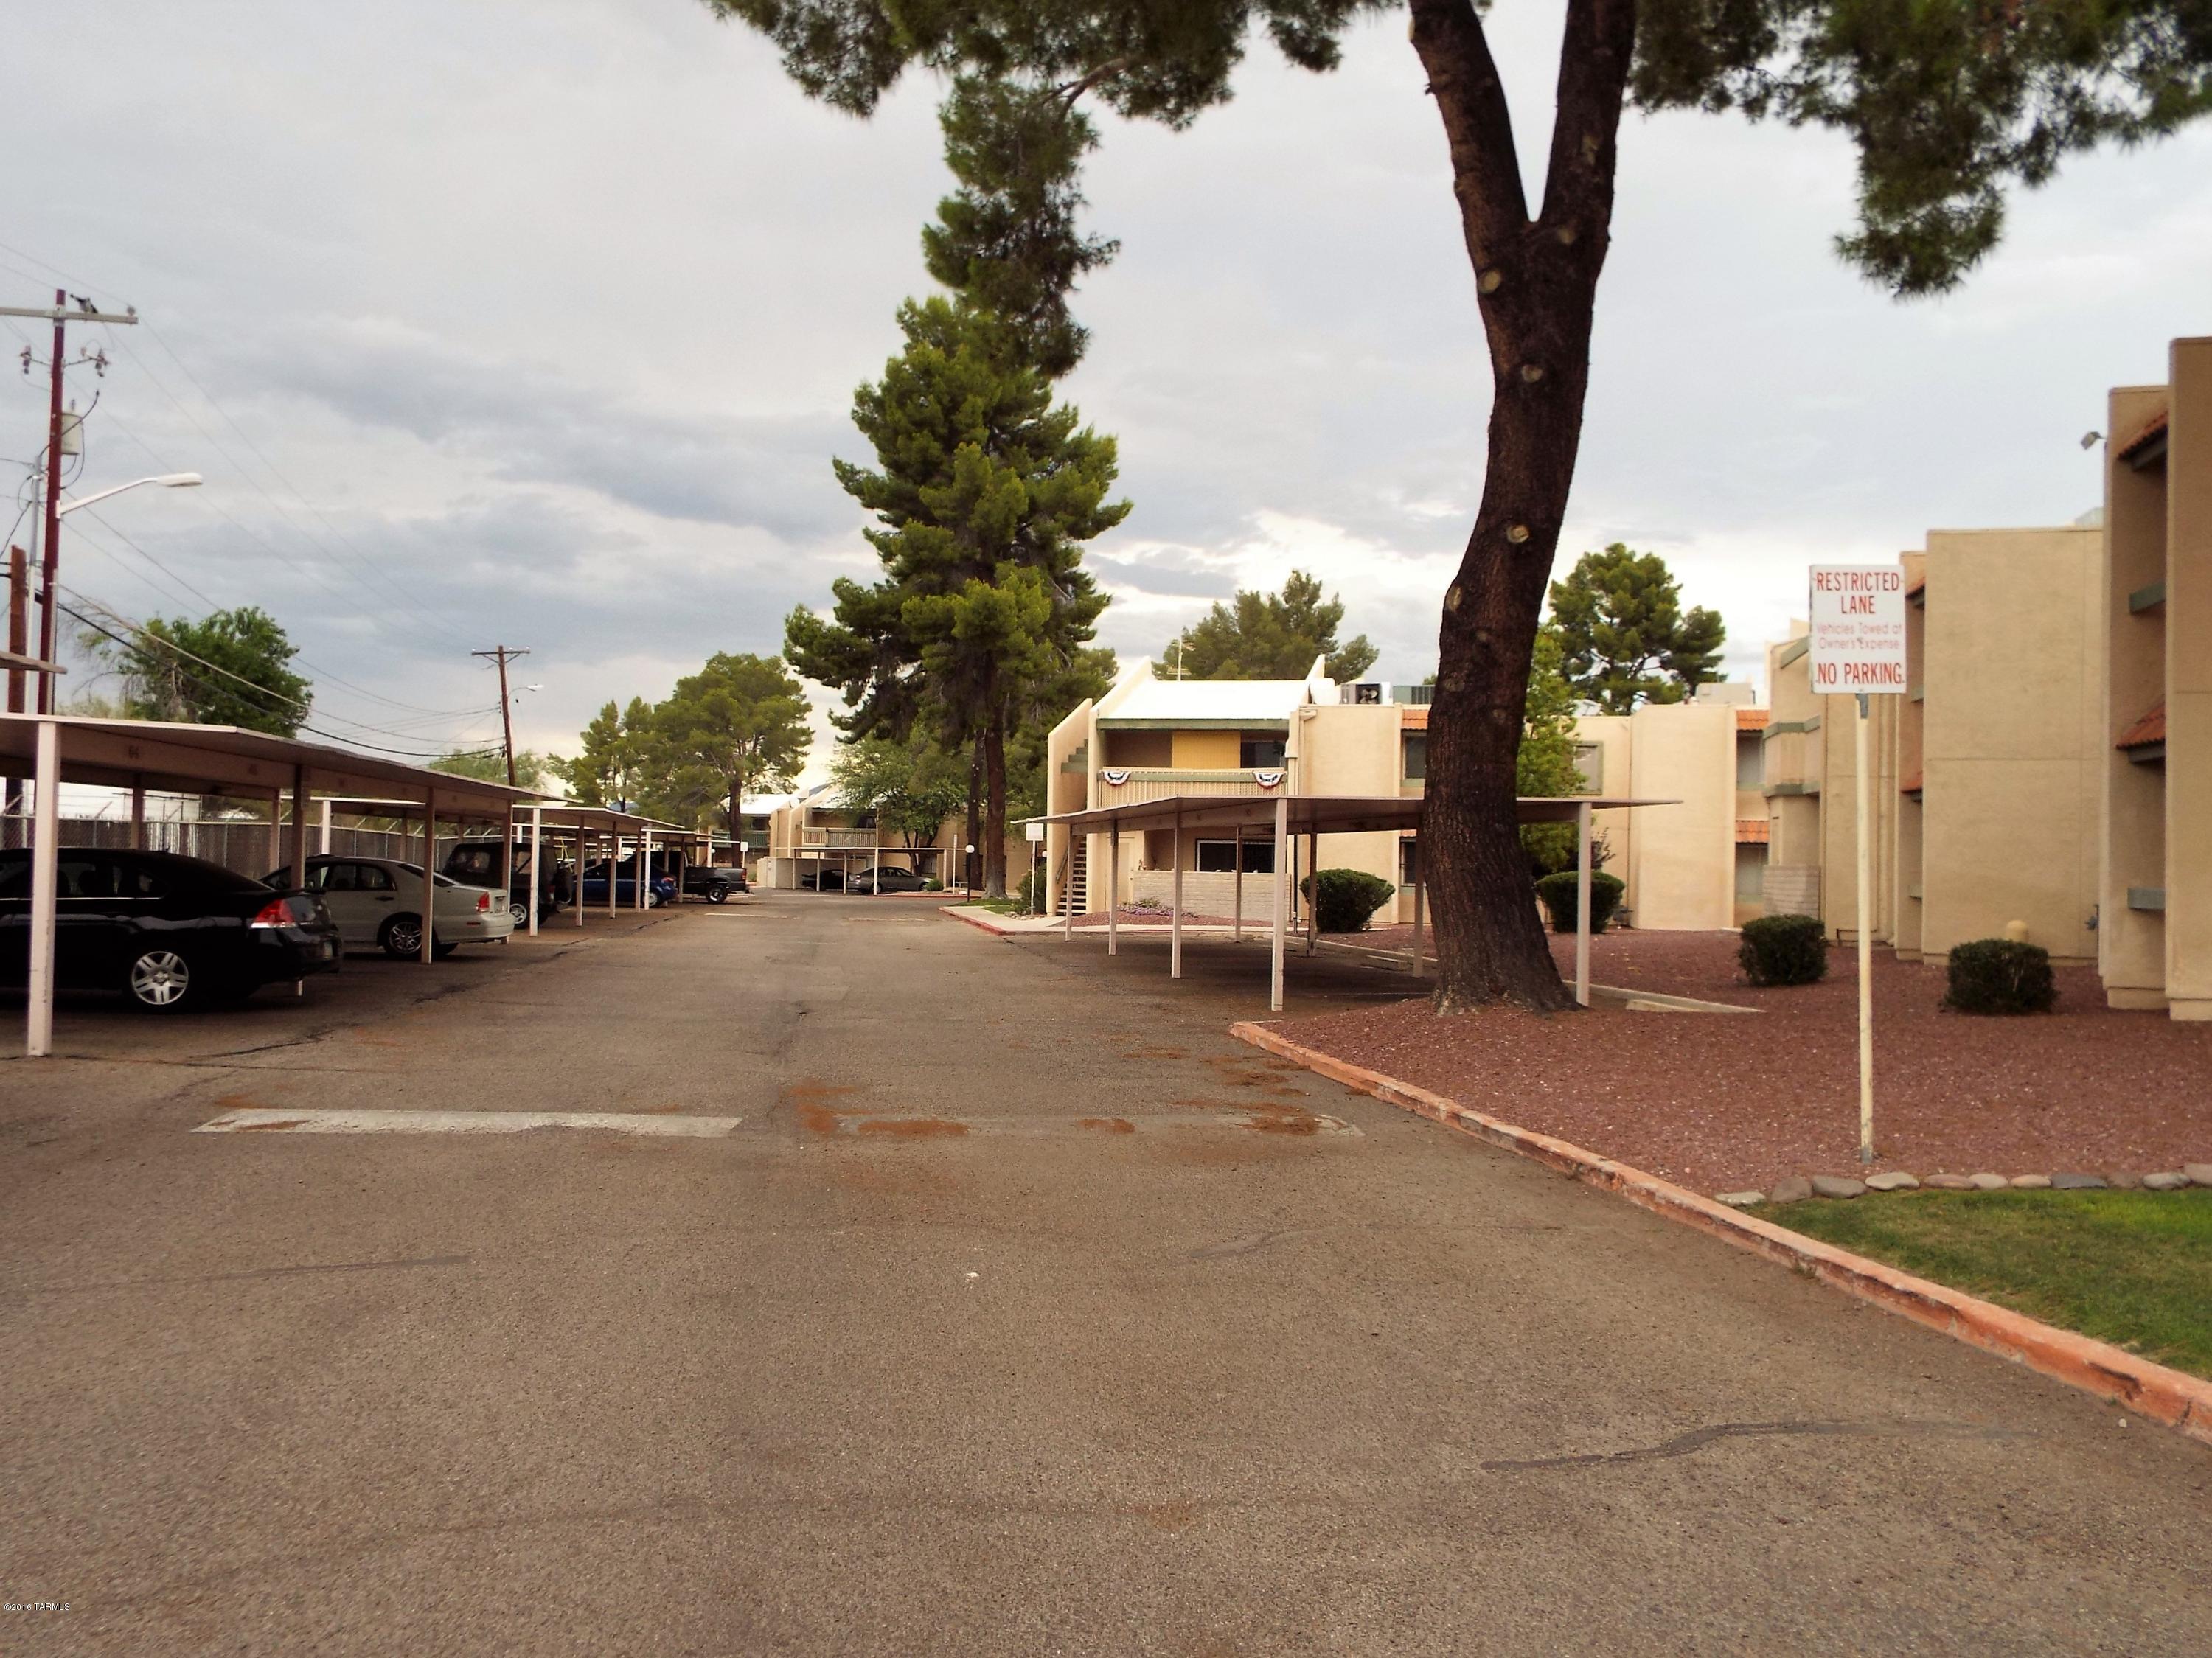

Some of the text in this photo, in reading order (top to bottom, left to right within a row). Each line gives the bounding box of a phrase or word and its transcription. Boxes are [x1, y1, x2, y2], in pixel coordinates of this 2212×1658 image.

[1816, 572, 1900, 591] RESTRICTED
[1841, 596, 1876, 614] LANE
[1817, 623, 1854, 634] Vehicles
[1859, 623, 1888, 634] Towed
[1859, 638, 1900, 650] Expense
[1818, 663, 1902, 684] NO PARKING
